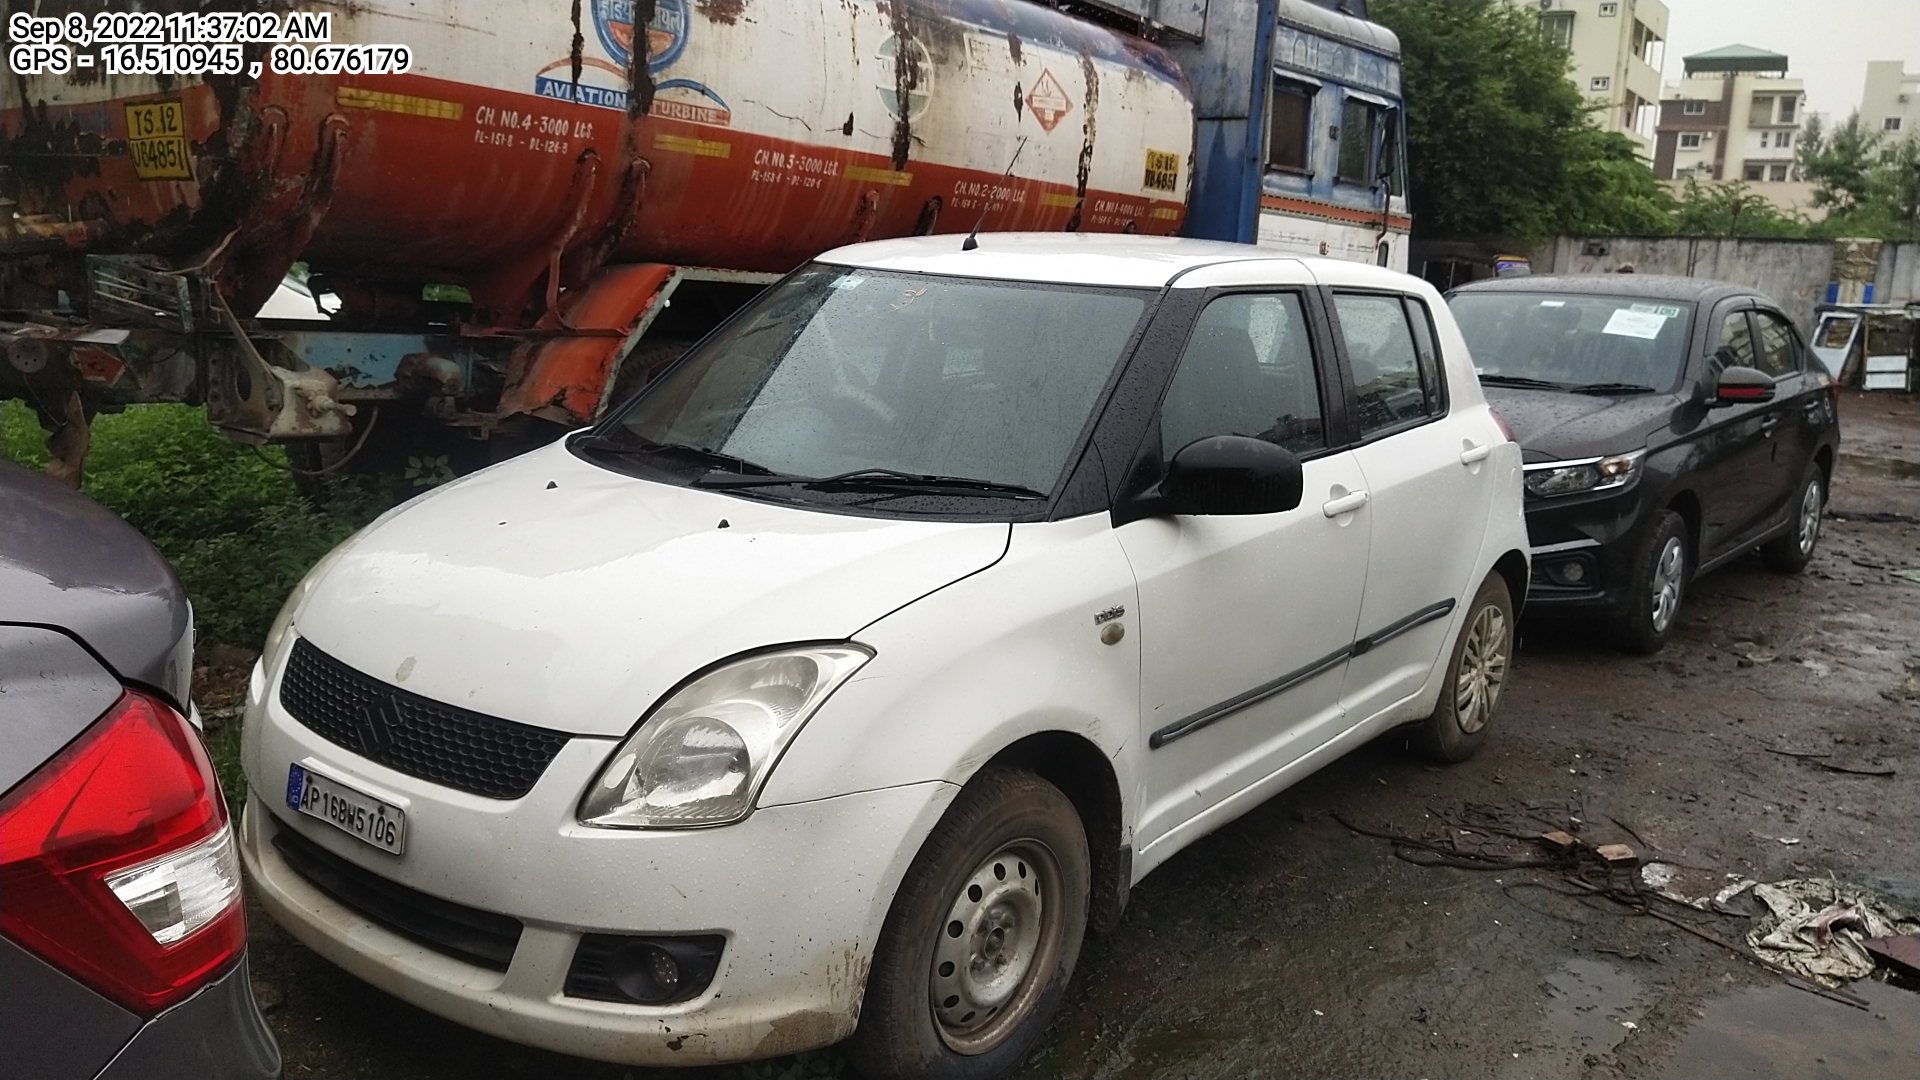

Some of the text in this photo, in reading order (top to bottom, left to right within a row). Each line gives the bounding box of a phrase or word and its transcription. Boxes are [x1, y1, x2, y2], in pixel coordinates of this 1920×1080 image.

[543, 80, 627, 108] AVIATION
[652, 99, 718, 122] TURBINE
[131, 139, 185, 171] UB4851
